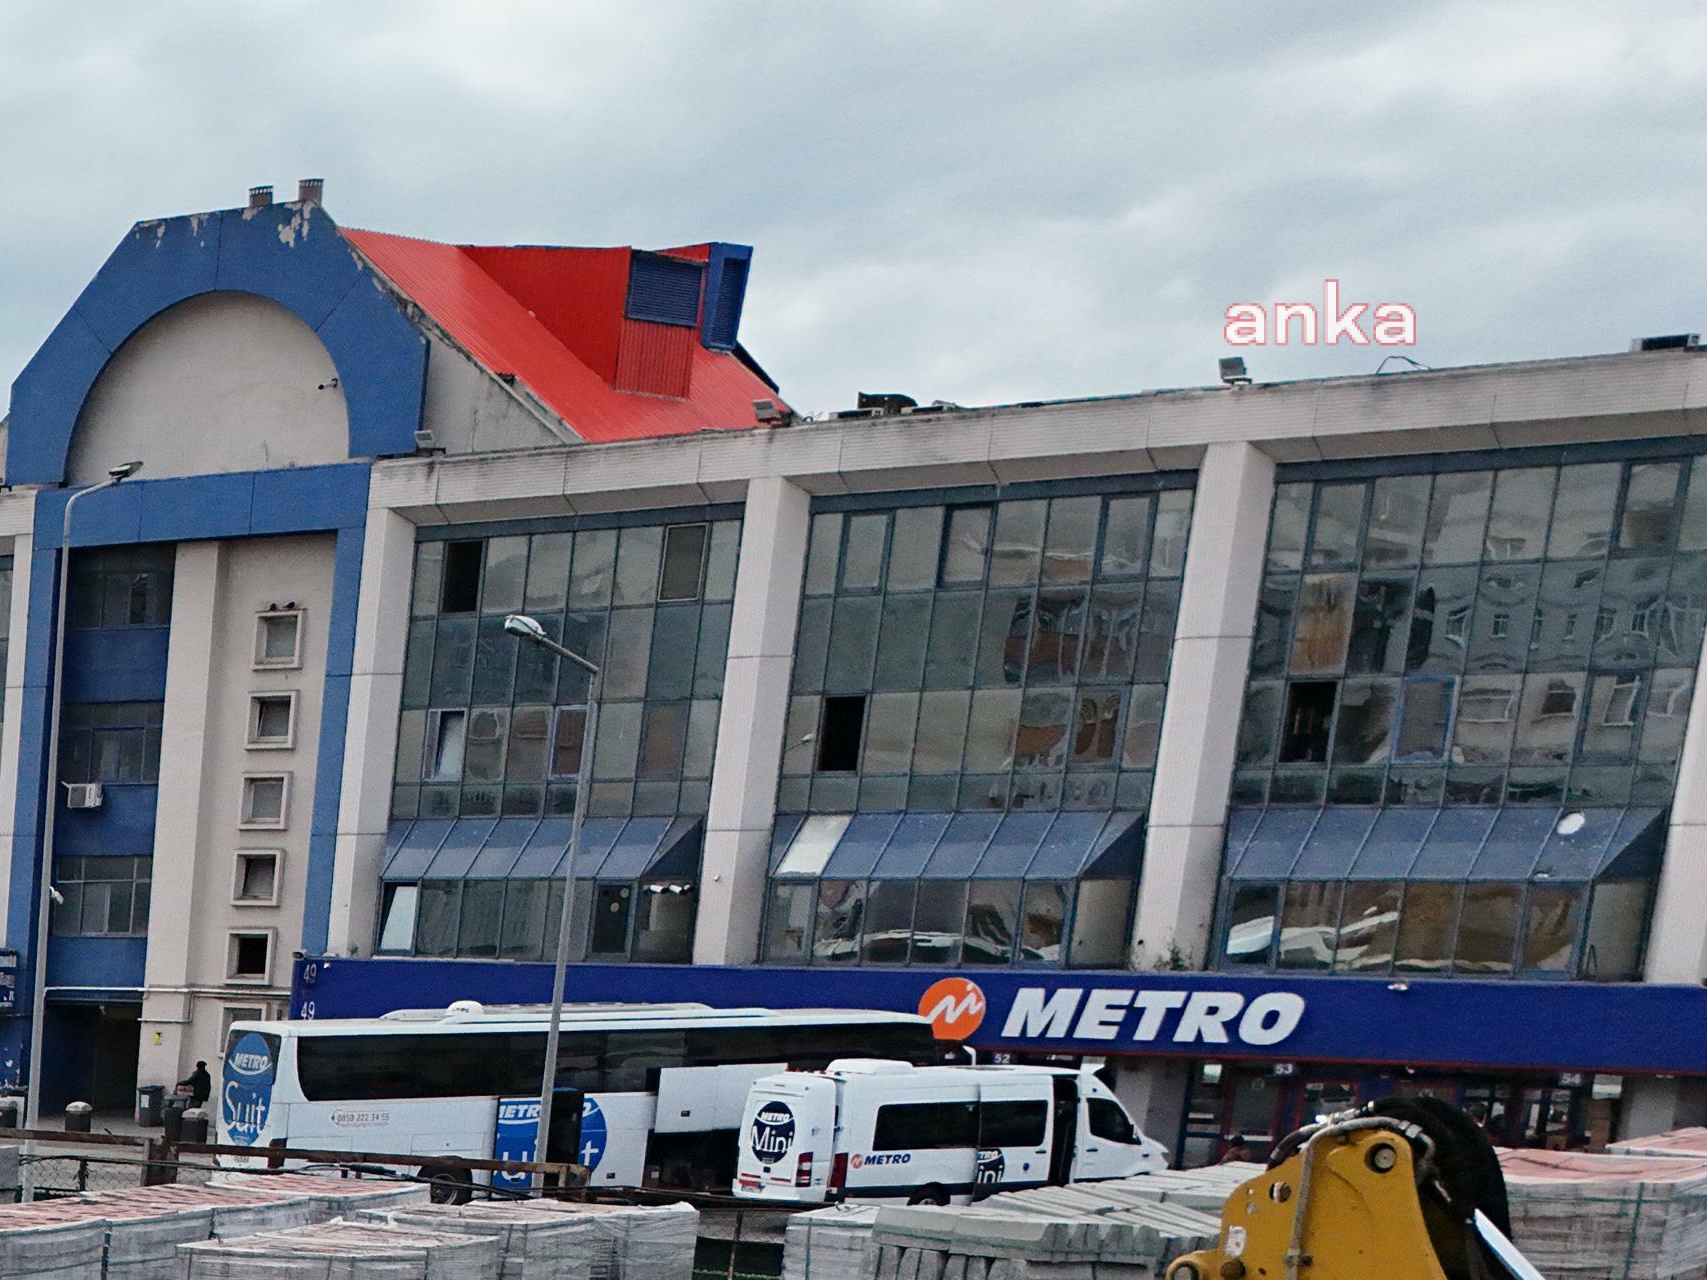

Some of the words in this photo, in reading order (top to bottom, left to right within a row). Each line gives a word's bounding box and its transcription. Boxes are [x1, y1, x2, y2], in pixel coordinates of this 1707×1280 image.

[303, 963, 317, 983] 49
[301, 1001, 315, 1020] 49
[1000, 987, 1306, 1046] METRO
[234, 1053, 269, 1071] METRO
[993, 1053, 1010, 1064] 52
[1274, 1063, 1294, 1076] 53
[1561, 1072, 1580, 1086] 54
[225, 1081, 266, 1134] Suit
[760, 1112, 790, 1122] METRO
[752, 1125, 793, 1153] Mini
[864, 1154, 911, 1166] METRO
